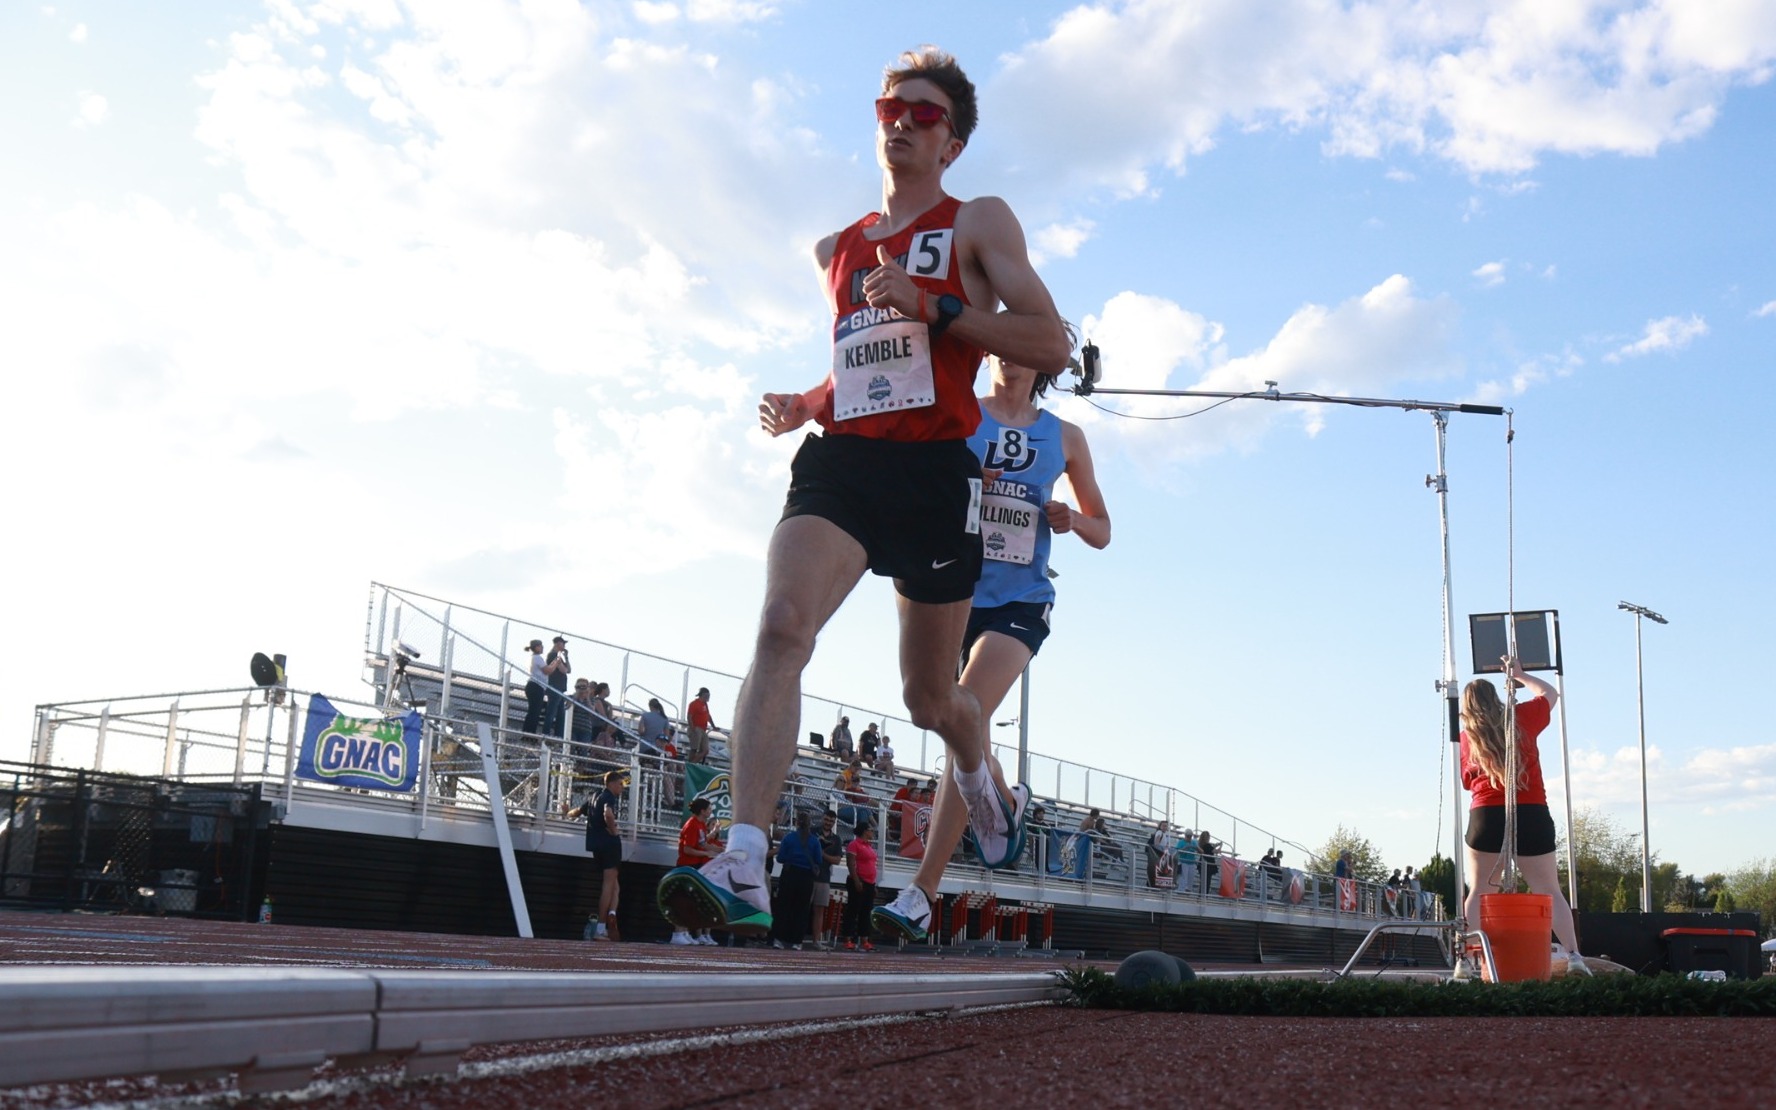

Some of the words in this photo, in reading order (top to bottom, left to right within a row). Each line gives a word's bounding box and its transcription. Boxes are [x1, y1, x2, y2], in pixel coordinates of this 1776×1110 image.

[915, 232, 943, 275] 5
[845, 336, 912, 369] KEMBLE
[1003, 430, 1022, 458] 8
[980, 504, 1030, 528] ILLINGS
[320, 735, 401, 779] GNAC
